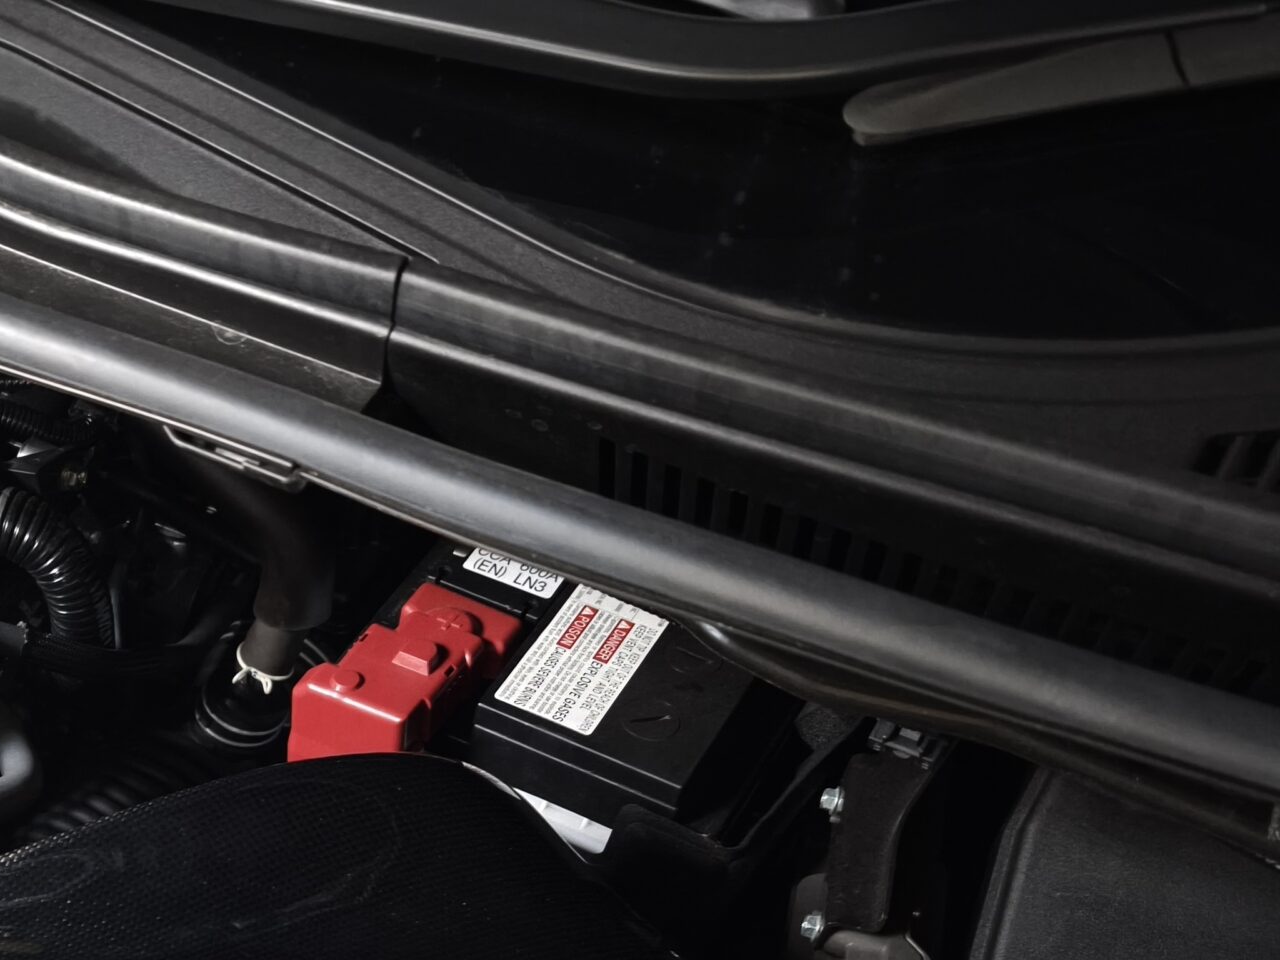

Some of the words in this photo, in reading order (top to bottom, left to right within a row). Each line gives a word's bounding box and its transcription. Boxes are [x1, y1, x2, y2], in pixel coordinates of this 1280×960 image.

[473, 557, 507, 578] (EN)
[513, 572, 547, 593] LN3
[558, 613, 591, 647] POISON
[594, 627, 627, 662] DANGER
[542, 645, 567, 669] CAUSES
[526, 665, 552, 689] SEVERE
[567, 659, 604, 699] EXPLOSIVE
[512, 685, 537, 707] BURNS
[549, 696, 577, 723] GASES
